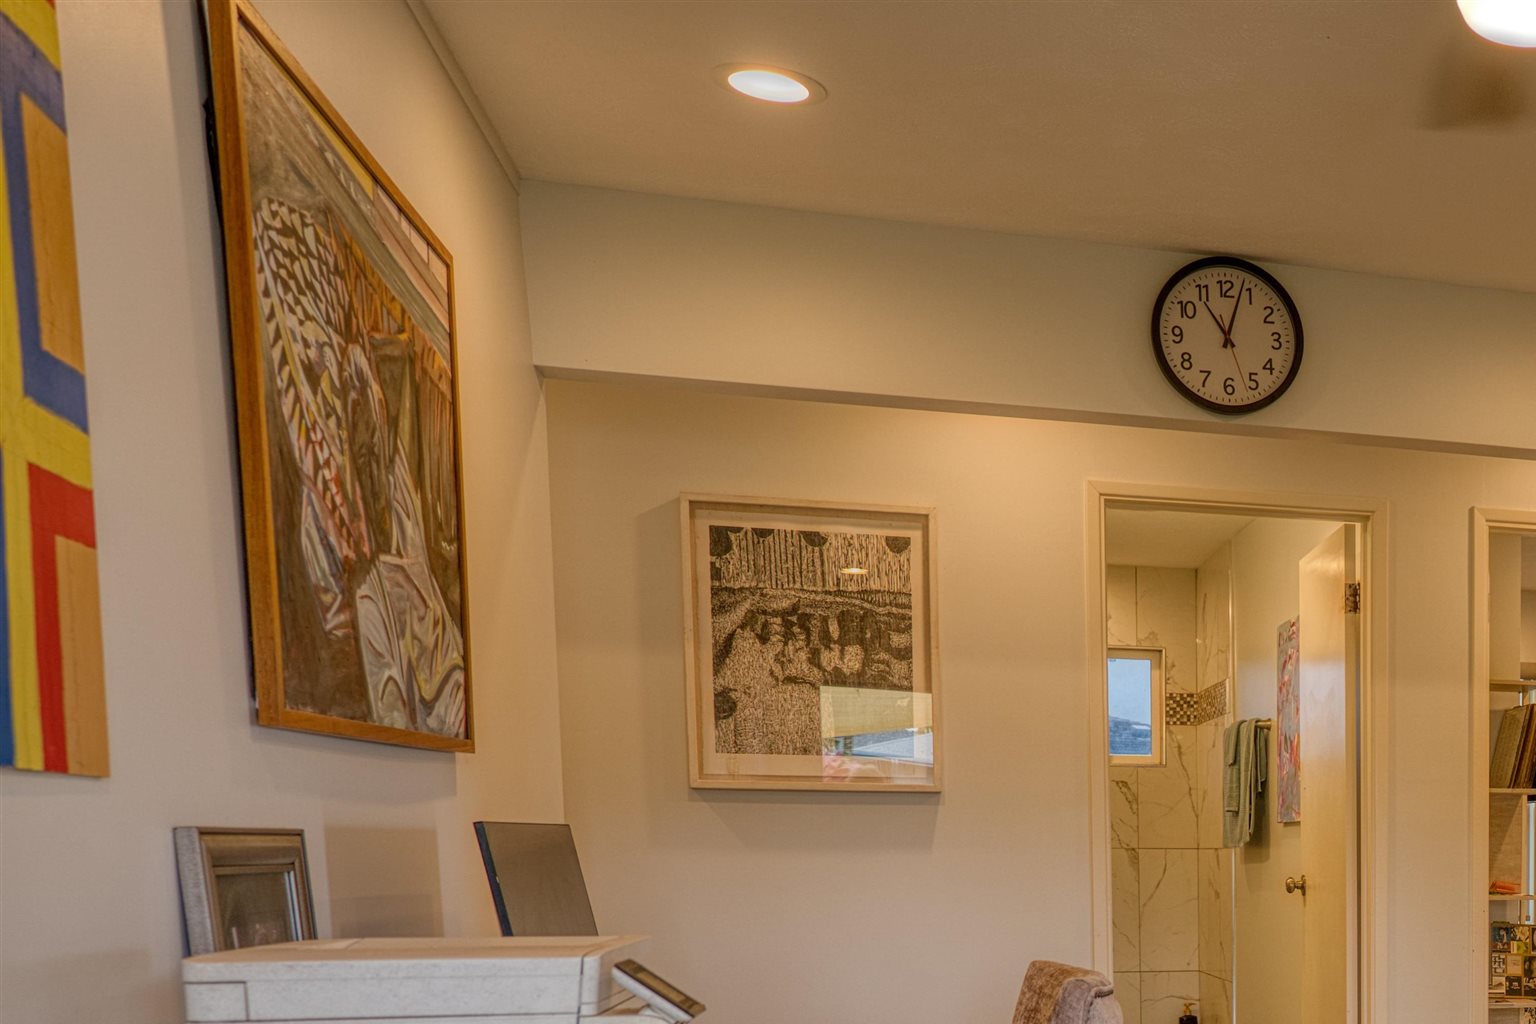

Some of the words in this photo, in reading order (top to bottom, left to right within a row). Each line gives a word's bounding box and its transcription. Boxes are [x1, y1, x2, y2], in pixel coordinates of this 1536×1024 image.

[1195, 284, 1209, 302] 11
[1216, 279, 1235, 298] 12
[1245, 287, 1253, 305] 1
[1177, 300, 1197, 319] 10
[1263, 306, 1275, 324] 2
[1171, 325, 1183, 344] 9
[1270, 331, 1282, 350] 3
[1180, 352, 1192, 371] 8
[1262, 358, 1275, 375] 4
[1199, 370, 1211, 388] 7
[1223, 377, 1235, 396] 6
[1248, 372, 1259, 391] 5
